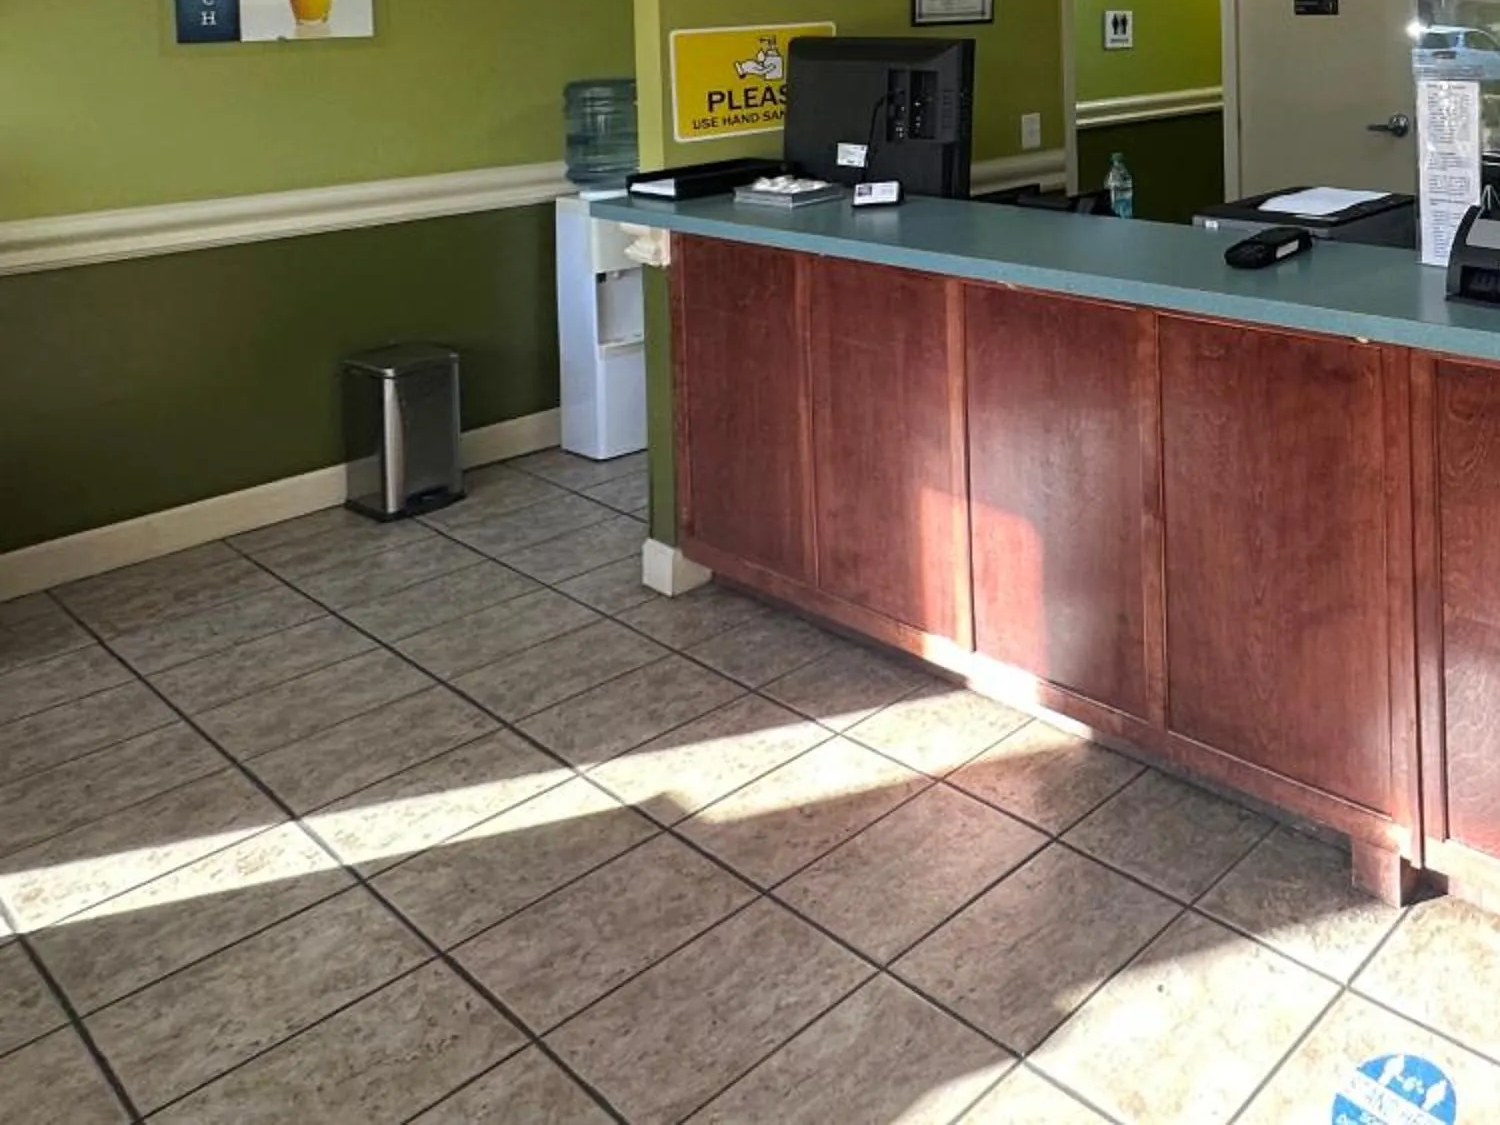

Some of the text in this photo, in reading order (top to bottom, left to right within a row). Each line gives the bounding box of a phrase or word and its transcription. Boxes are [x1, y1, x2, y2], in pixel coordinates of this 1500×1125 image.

[707, 83, 788, 113] PLEAS
[692, 110, 786, 130] USE HAND SAN
